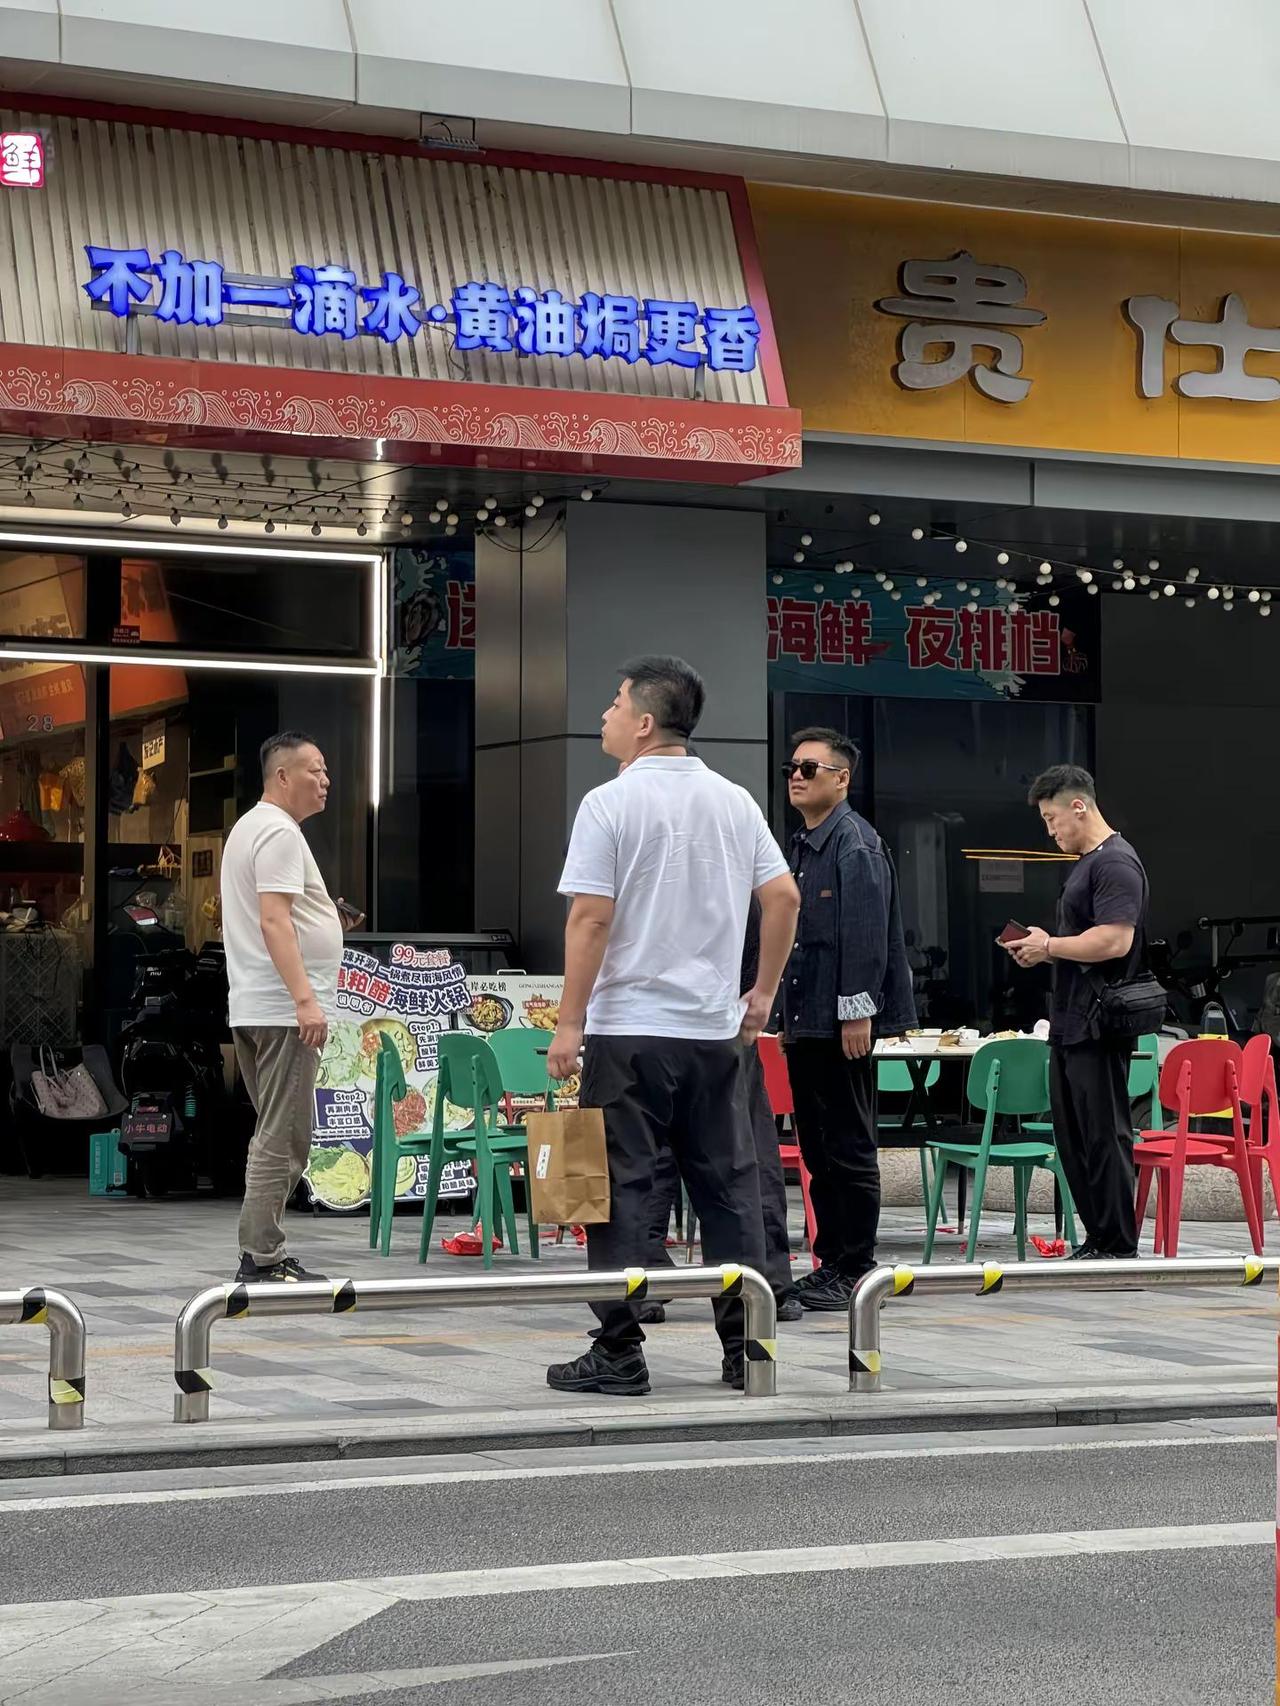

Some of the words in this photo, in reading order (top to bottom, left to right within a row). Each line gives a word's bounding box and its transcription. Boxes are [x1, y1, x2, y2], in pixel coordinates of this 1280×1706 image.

[767, 596, 872, 667] 海鲜
[904, 605, 1061, 676] 夜排档
[26, 714, 55, 733] 28
[411, 1022, 439, 1033] Step1:
[335, 1091, 364, 1102] Step2:
[124, 1122, 168, 1134] 小牛电动
